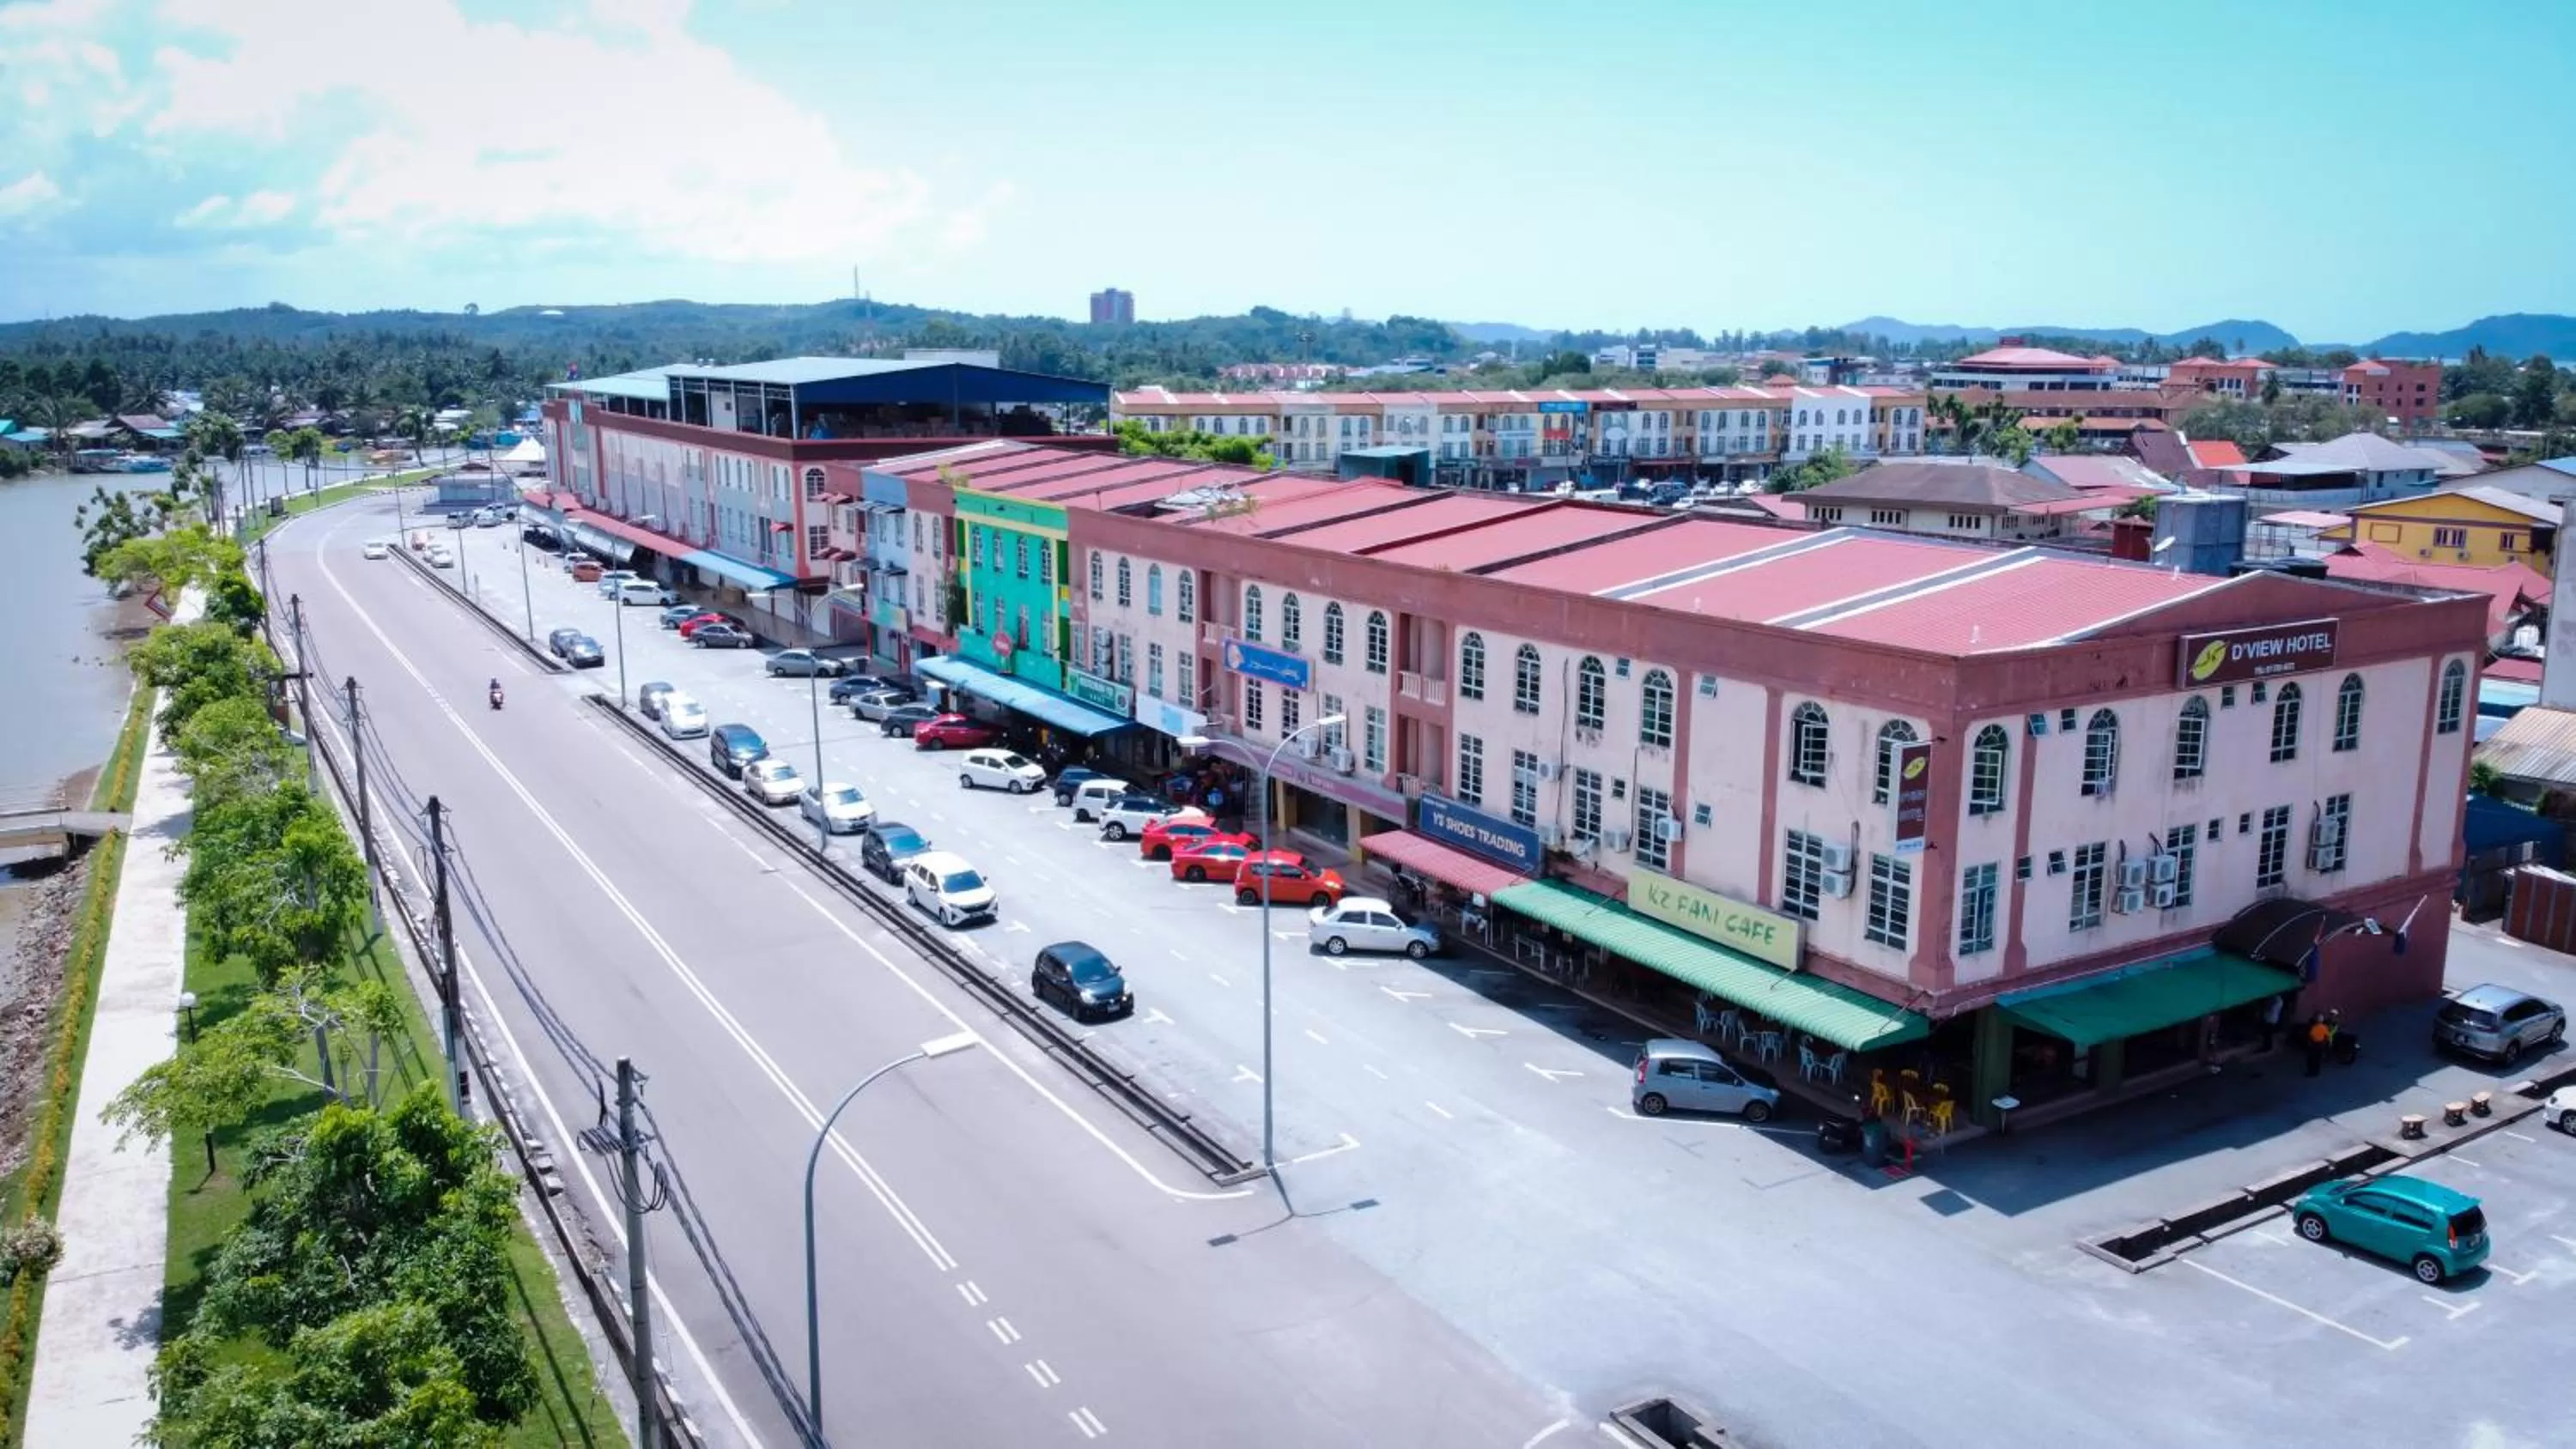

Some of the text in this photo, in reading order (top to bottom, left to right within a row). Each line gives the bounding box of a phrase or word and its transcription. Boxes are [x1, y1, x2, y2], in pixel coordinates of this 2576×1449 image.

[2232, 633, 2332, 661] D'VIEW HOTEL
[1446, 816, 1476, 839] SHOES
[1477, 828, 1526, 858] TRADING
[1725, 913, 1777, 945] CAFE
